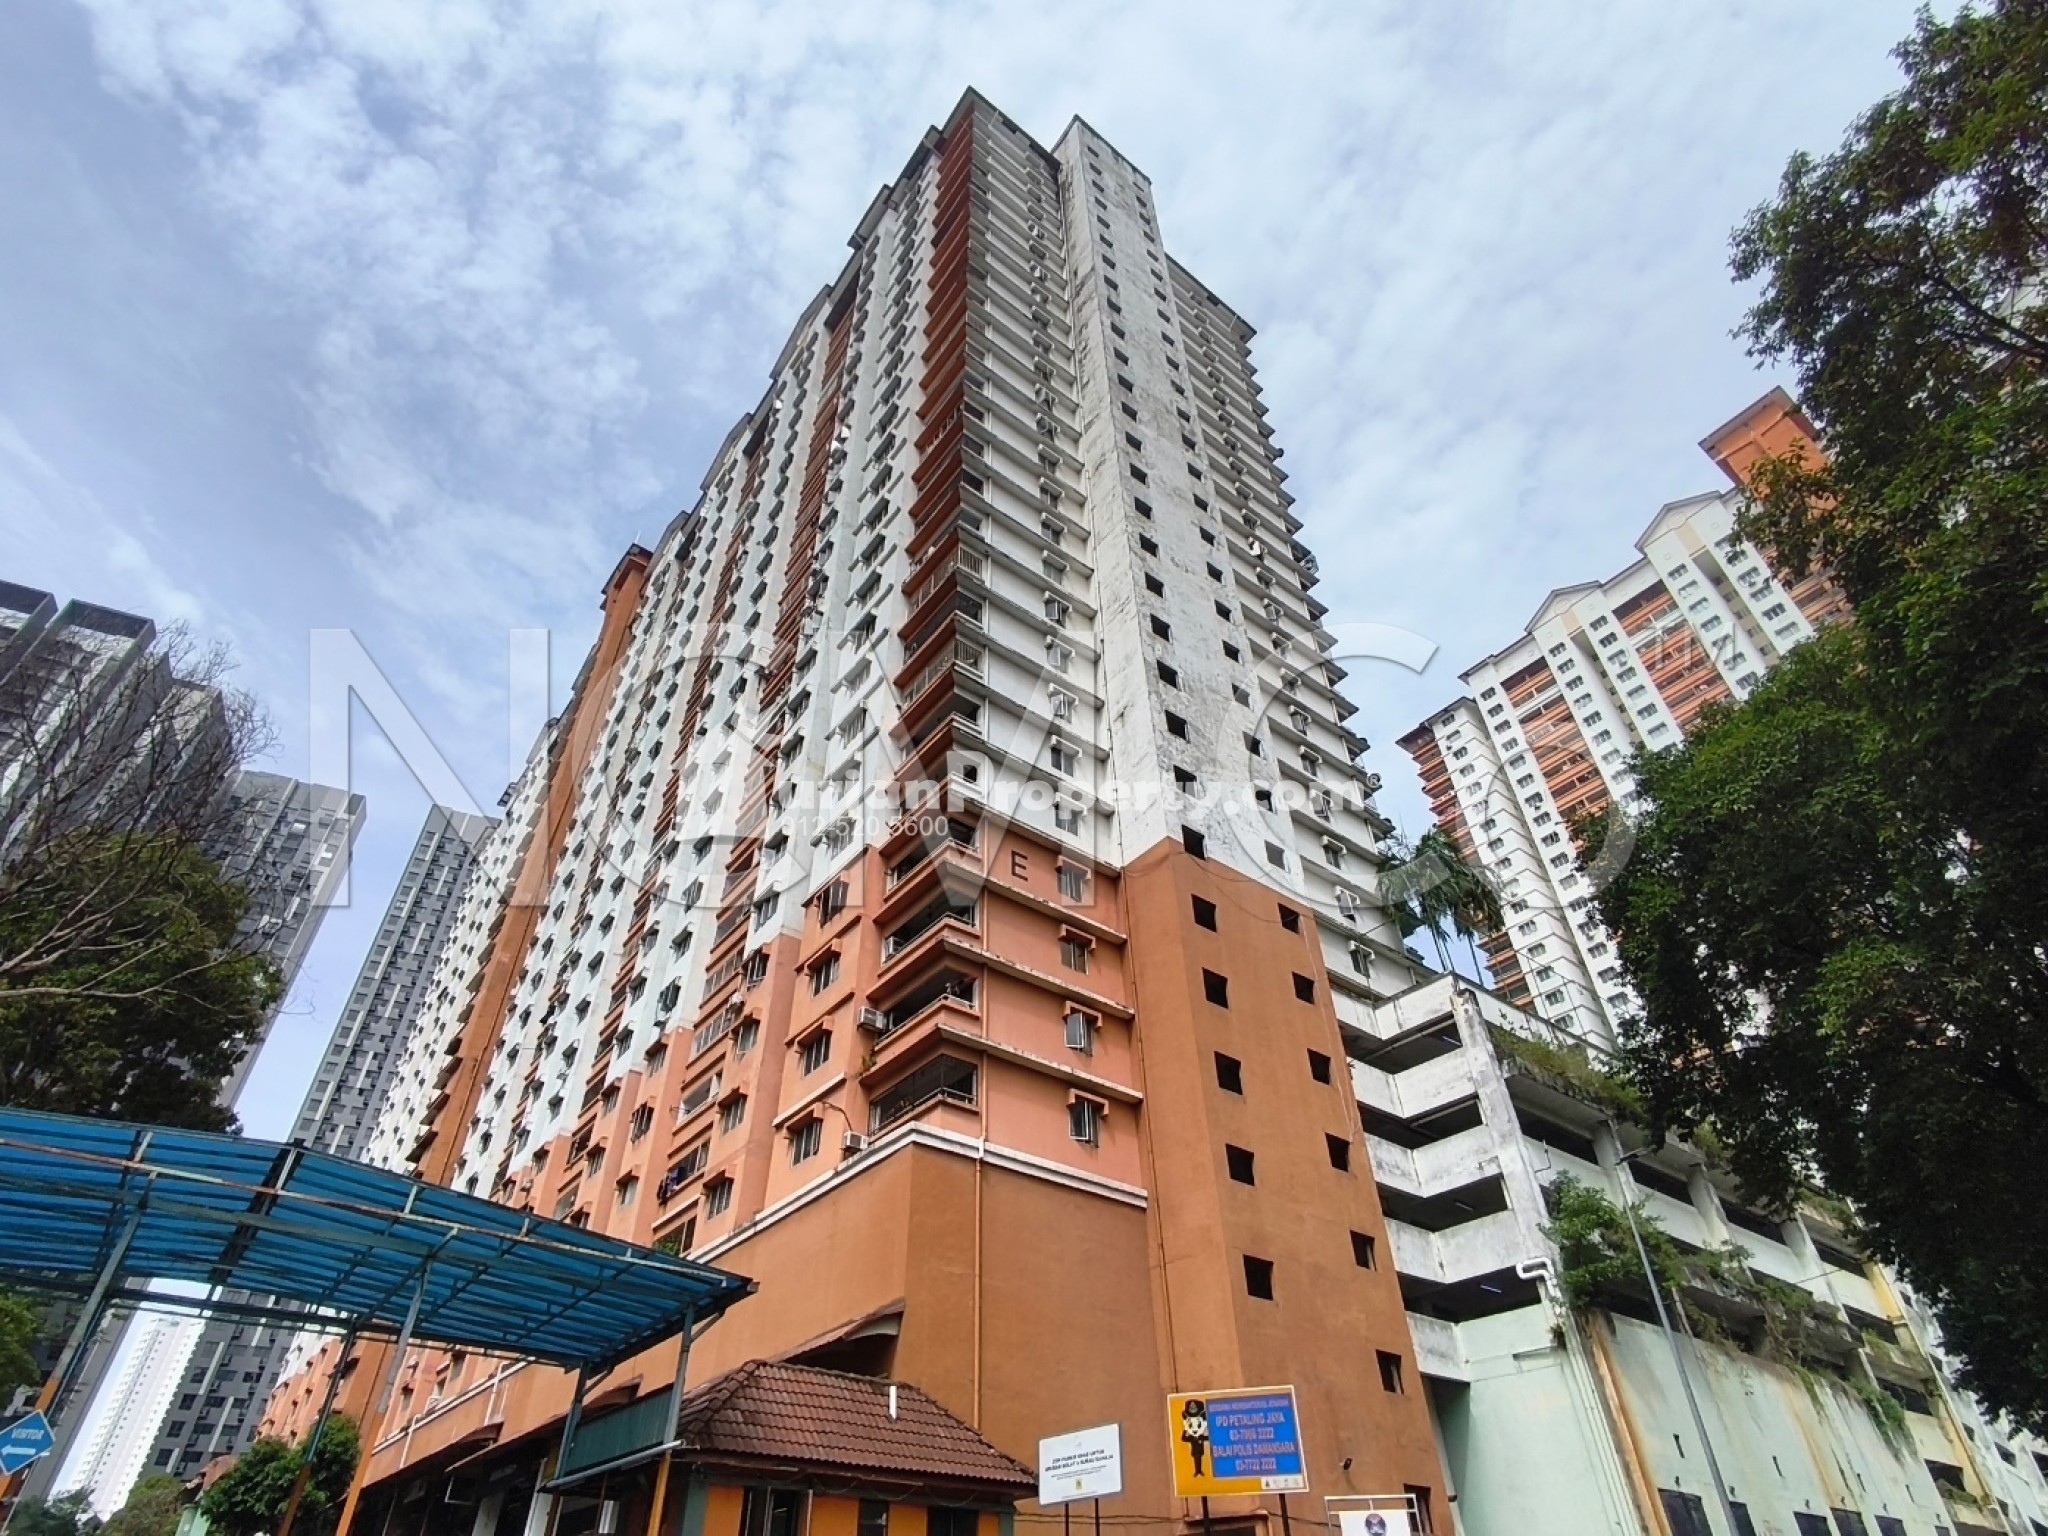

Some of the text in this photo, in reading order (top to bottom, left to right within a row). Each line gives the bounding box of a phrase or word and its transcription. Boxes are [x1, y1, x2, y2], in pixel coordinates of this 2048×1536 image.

[1011, 850, 1028, 882] E
[1229, 1412, 1265, 1427] PETALING
[1266, 1411, 1285, 1424] JAYA
[1213, 1444, 1233, 1457] BALAI
[1233, 1443, 1252, 1456] POLIS
